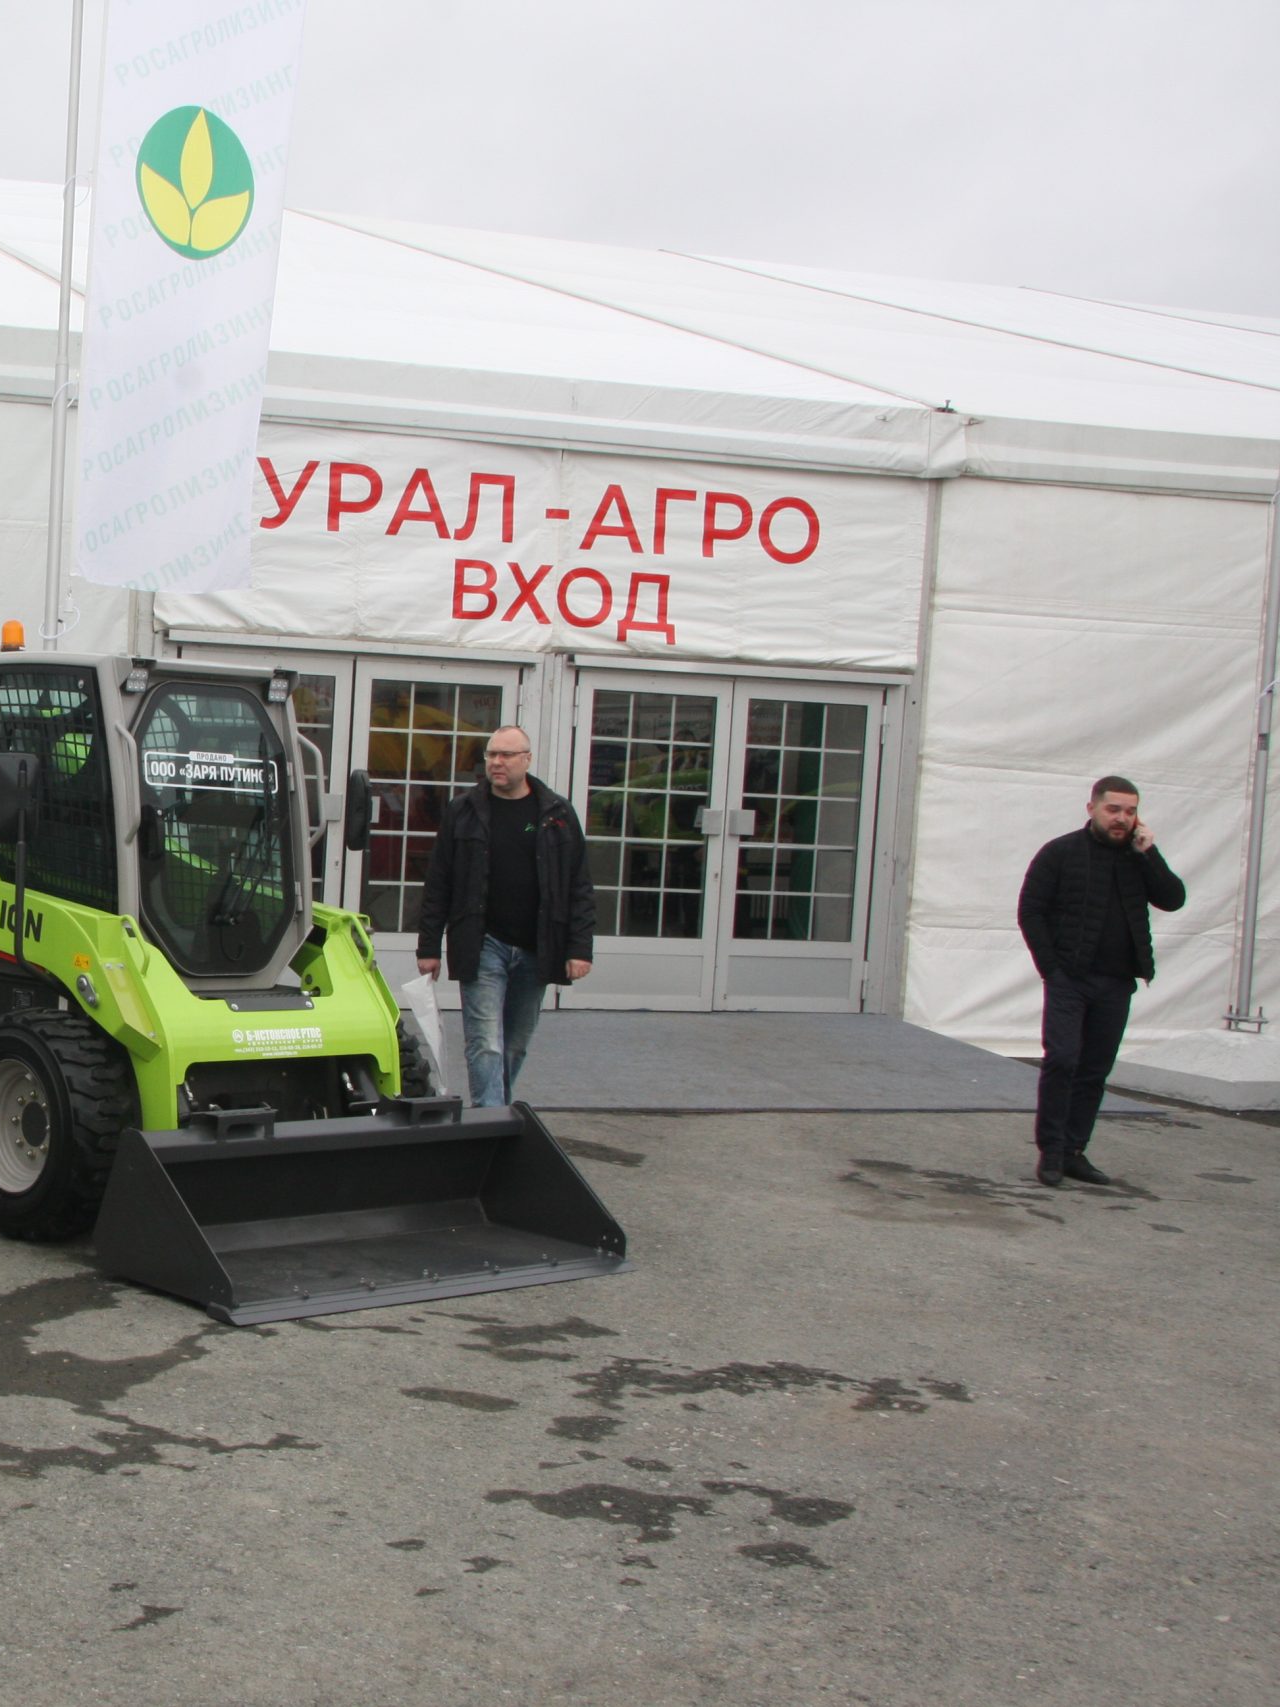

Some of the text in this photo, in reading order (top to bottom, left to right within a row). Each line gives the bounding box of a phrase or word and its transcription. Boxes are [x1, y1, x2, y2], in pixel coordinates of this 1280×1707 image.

[451, 558, 676, 646] ВХОД
[196, 752, 227, 762] ПРОДАНО
[150, 761, 176, 777] ООО
[179, 763, 218, 781] «ЗАРЯ
